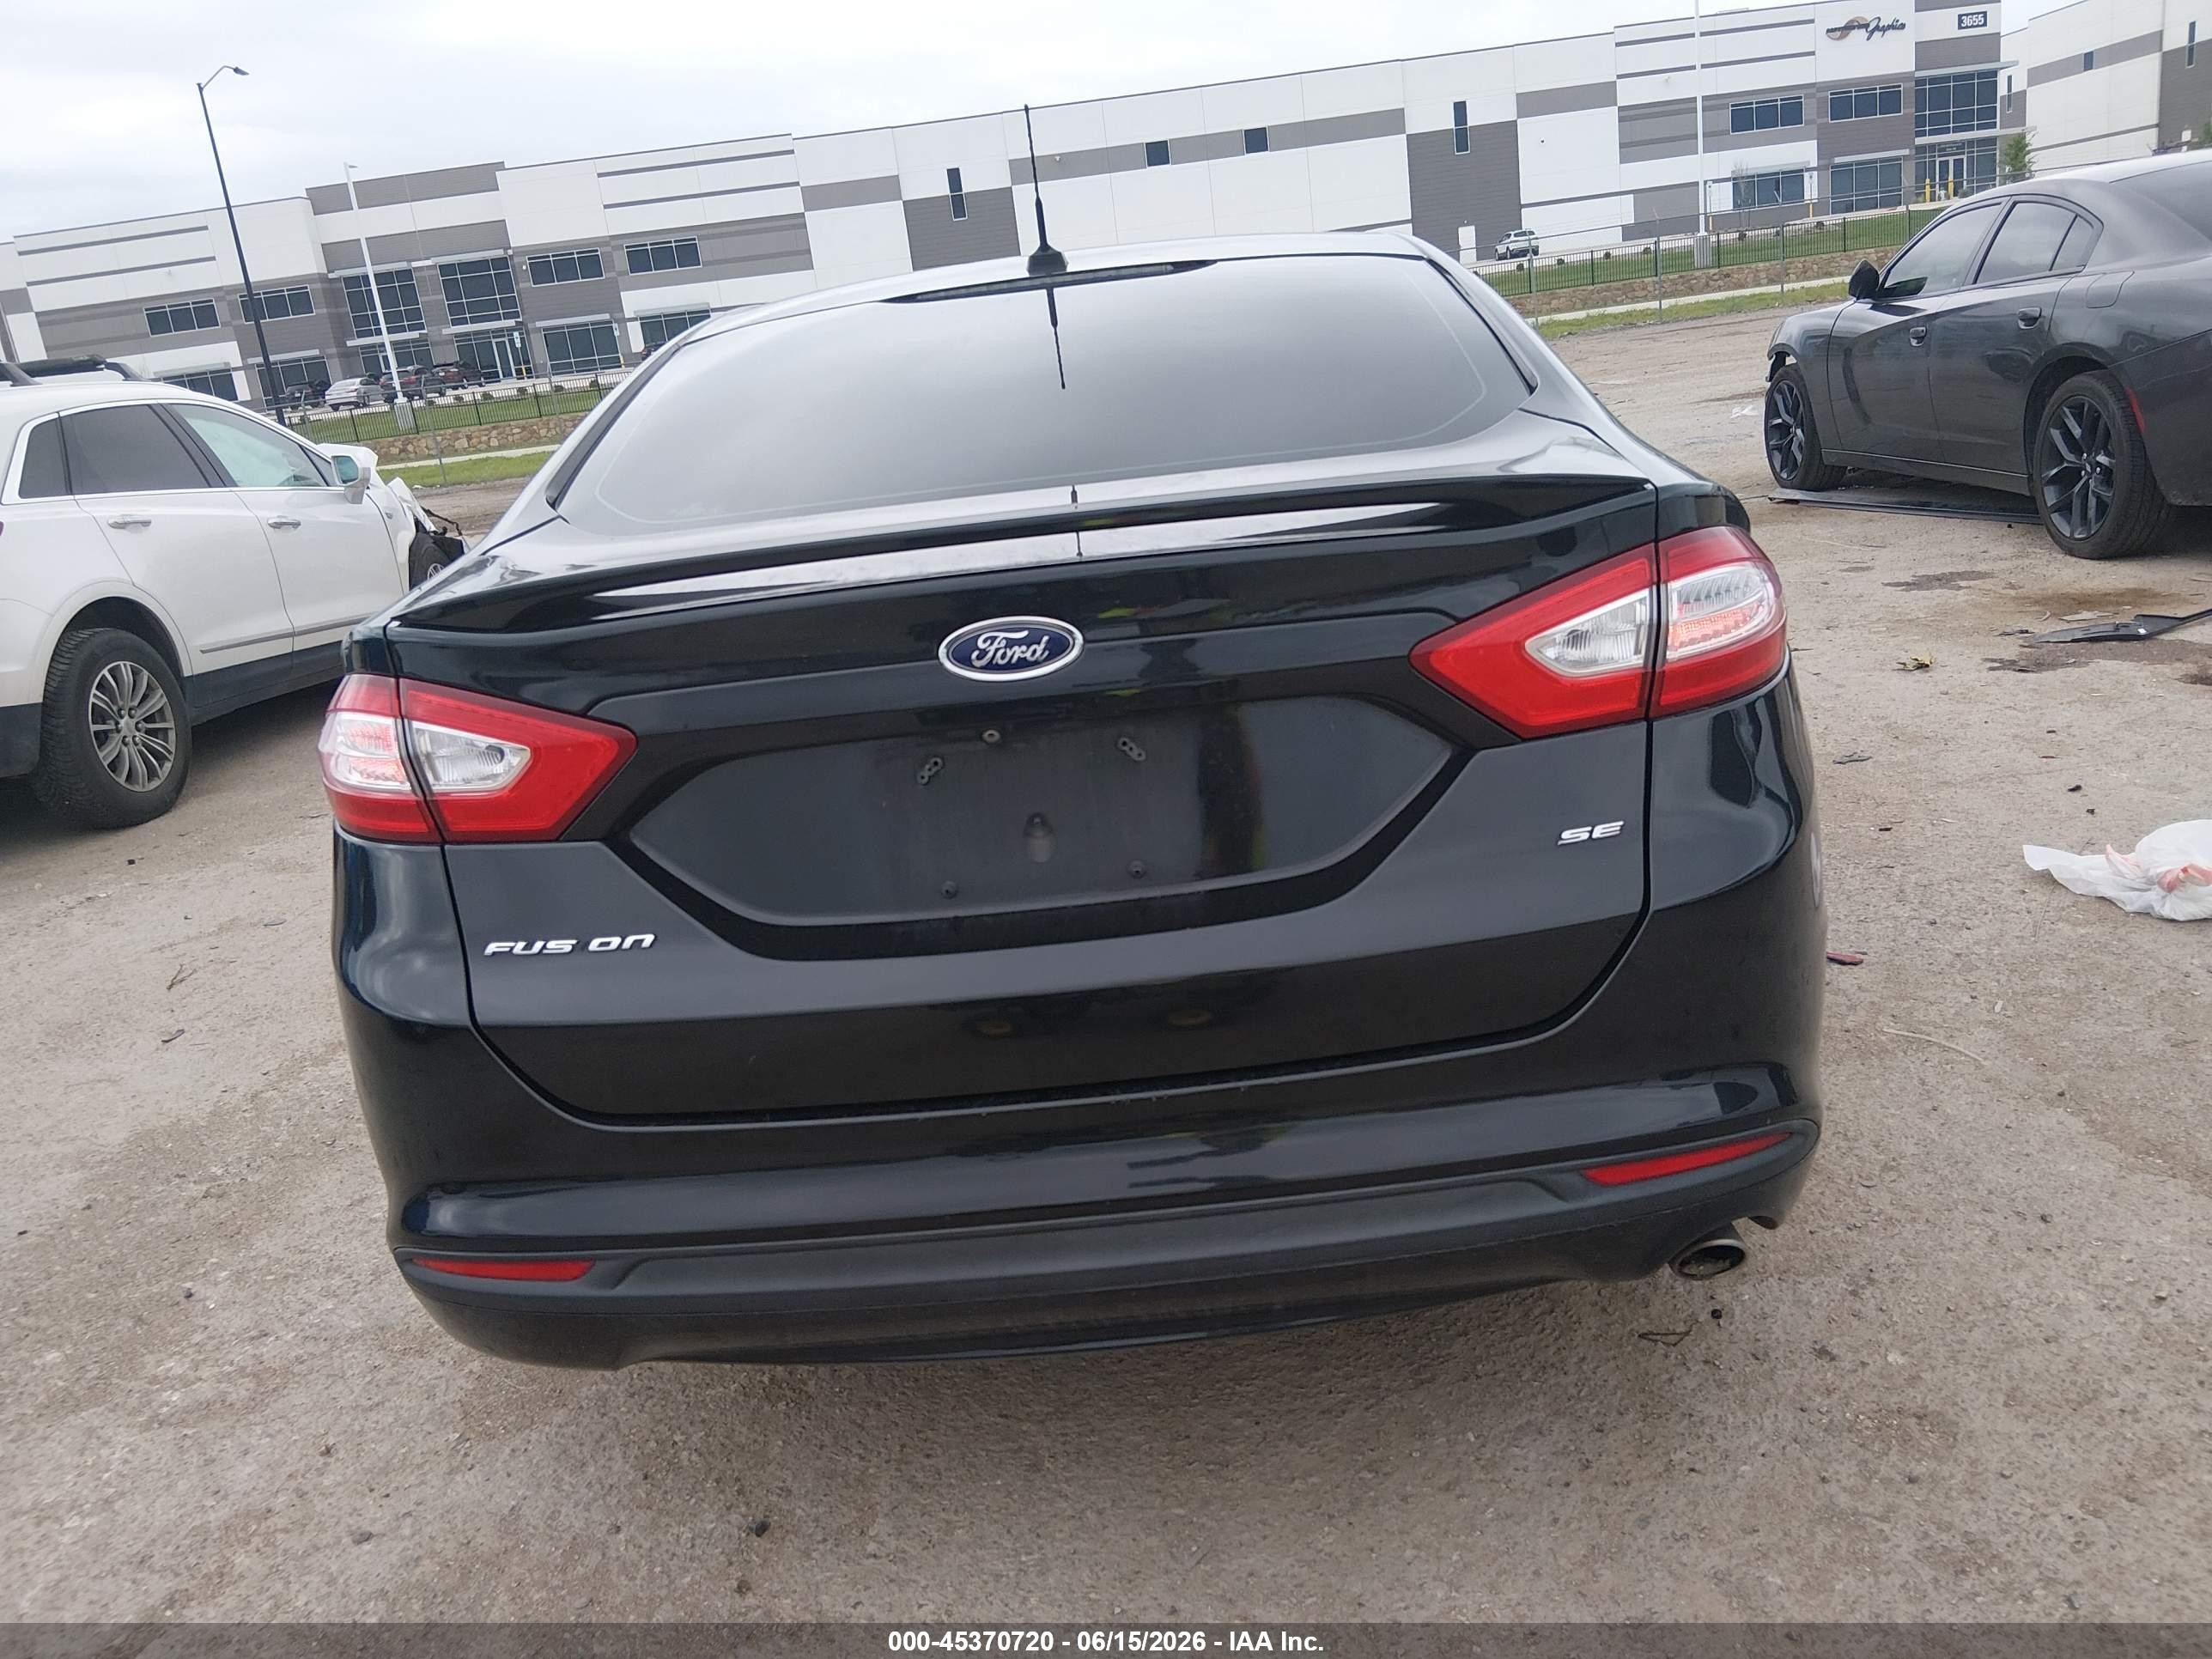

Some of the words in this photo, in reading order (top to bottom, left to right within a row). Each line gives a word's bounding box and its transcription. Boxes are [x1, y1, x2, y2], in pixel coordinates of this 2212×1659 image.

[1960, 14, 1984, 27] 3655
[970, 629, 1050, 668] Ford
[1557, 820, 1625, 846] SE
